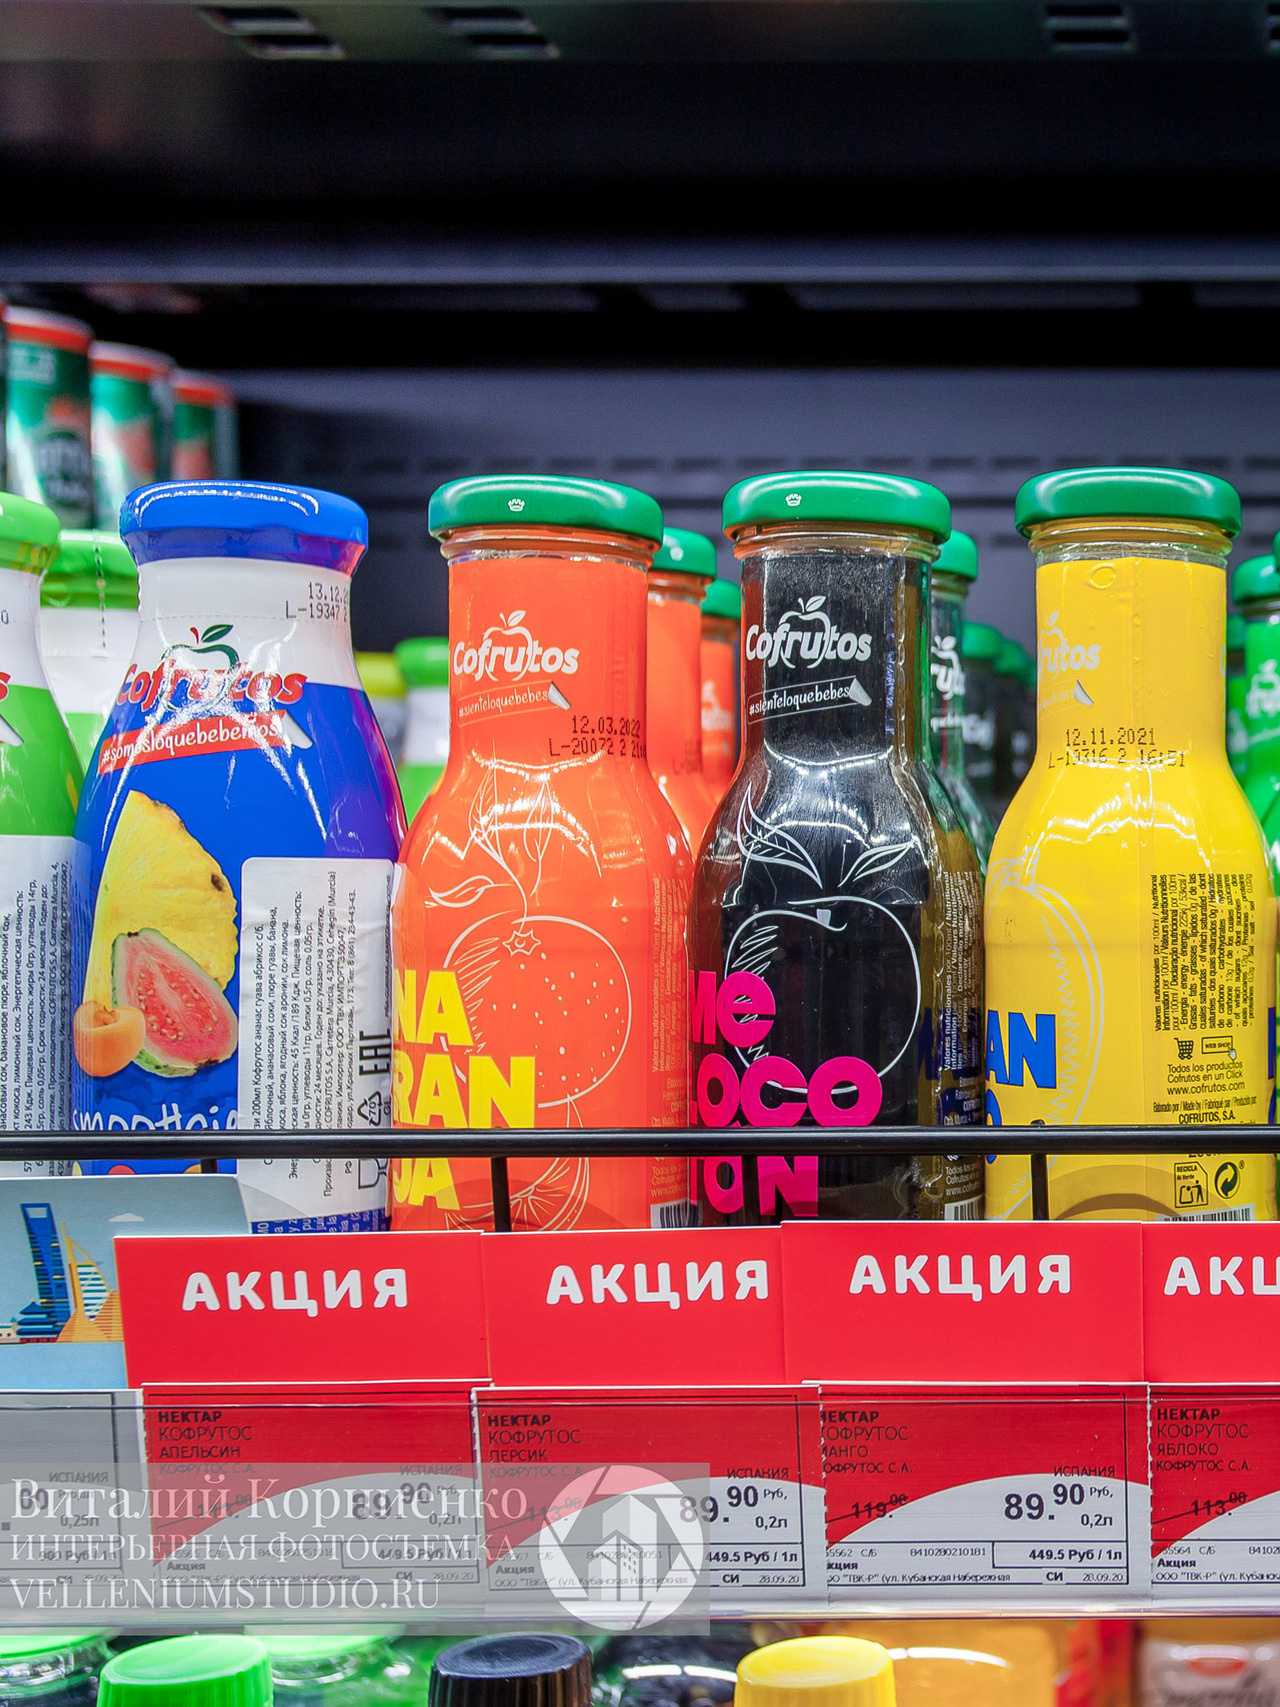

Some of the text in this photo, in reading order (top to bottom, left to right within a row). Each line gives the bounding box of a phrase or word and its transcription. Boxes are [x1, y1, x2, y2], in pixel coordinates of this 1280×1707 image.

[746, 623, 872, 668] Cofrutos
[453, 637, 580, 682] Cofrutos
[458, 688, 548, 719] #sienteloquebebes
[749, 683, 850, 715] #sienteloquebebes
[1065, 727, 1156, 746] 12.11.2021
[252, 1042, 263, 1086] Кофрутос
[1167, 1061, 1243, 1073] Todos los productos
[1167, 1070, 1243, 1084] Cofrutos en un Click
[1167, 1080, 1245, 1096] www.cofrutos.com
[546, 1260, 770, 1310] АКЦИЯ
[849, 1254, 1072, 1303] АКЦИЯ
[181, 1267, 409, 1317] АКЦИЯ
[158, 1411, 222, 1423] НЕКТАР
[488, 1414, 551, 1427] НЕКТАР
[1157, 1408, 1220, 1420] НЕКТАР
[159, 1425, 252, 1442] КОФРУТОС
[489, 1429, 581, 1445] КОФРУТОС
[1157, 1423, 1249, 1439] КОФРУТОС
[160, 1446, 241, 1459] АПЕЛЬСИН
[490, 1449, 548, 1462] ПЕРСИК
[1157, 1443, 1219, 1456] ЯБЛОКО
[1053, 1466, 1115, 1477] ИСПАНИЯ
[167, 1561, 206, 1572] Акция
